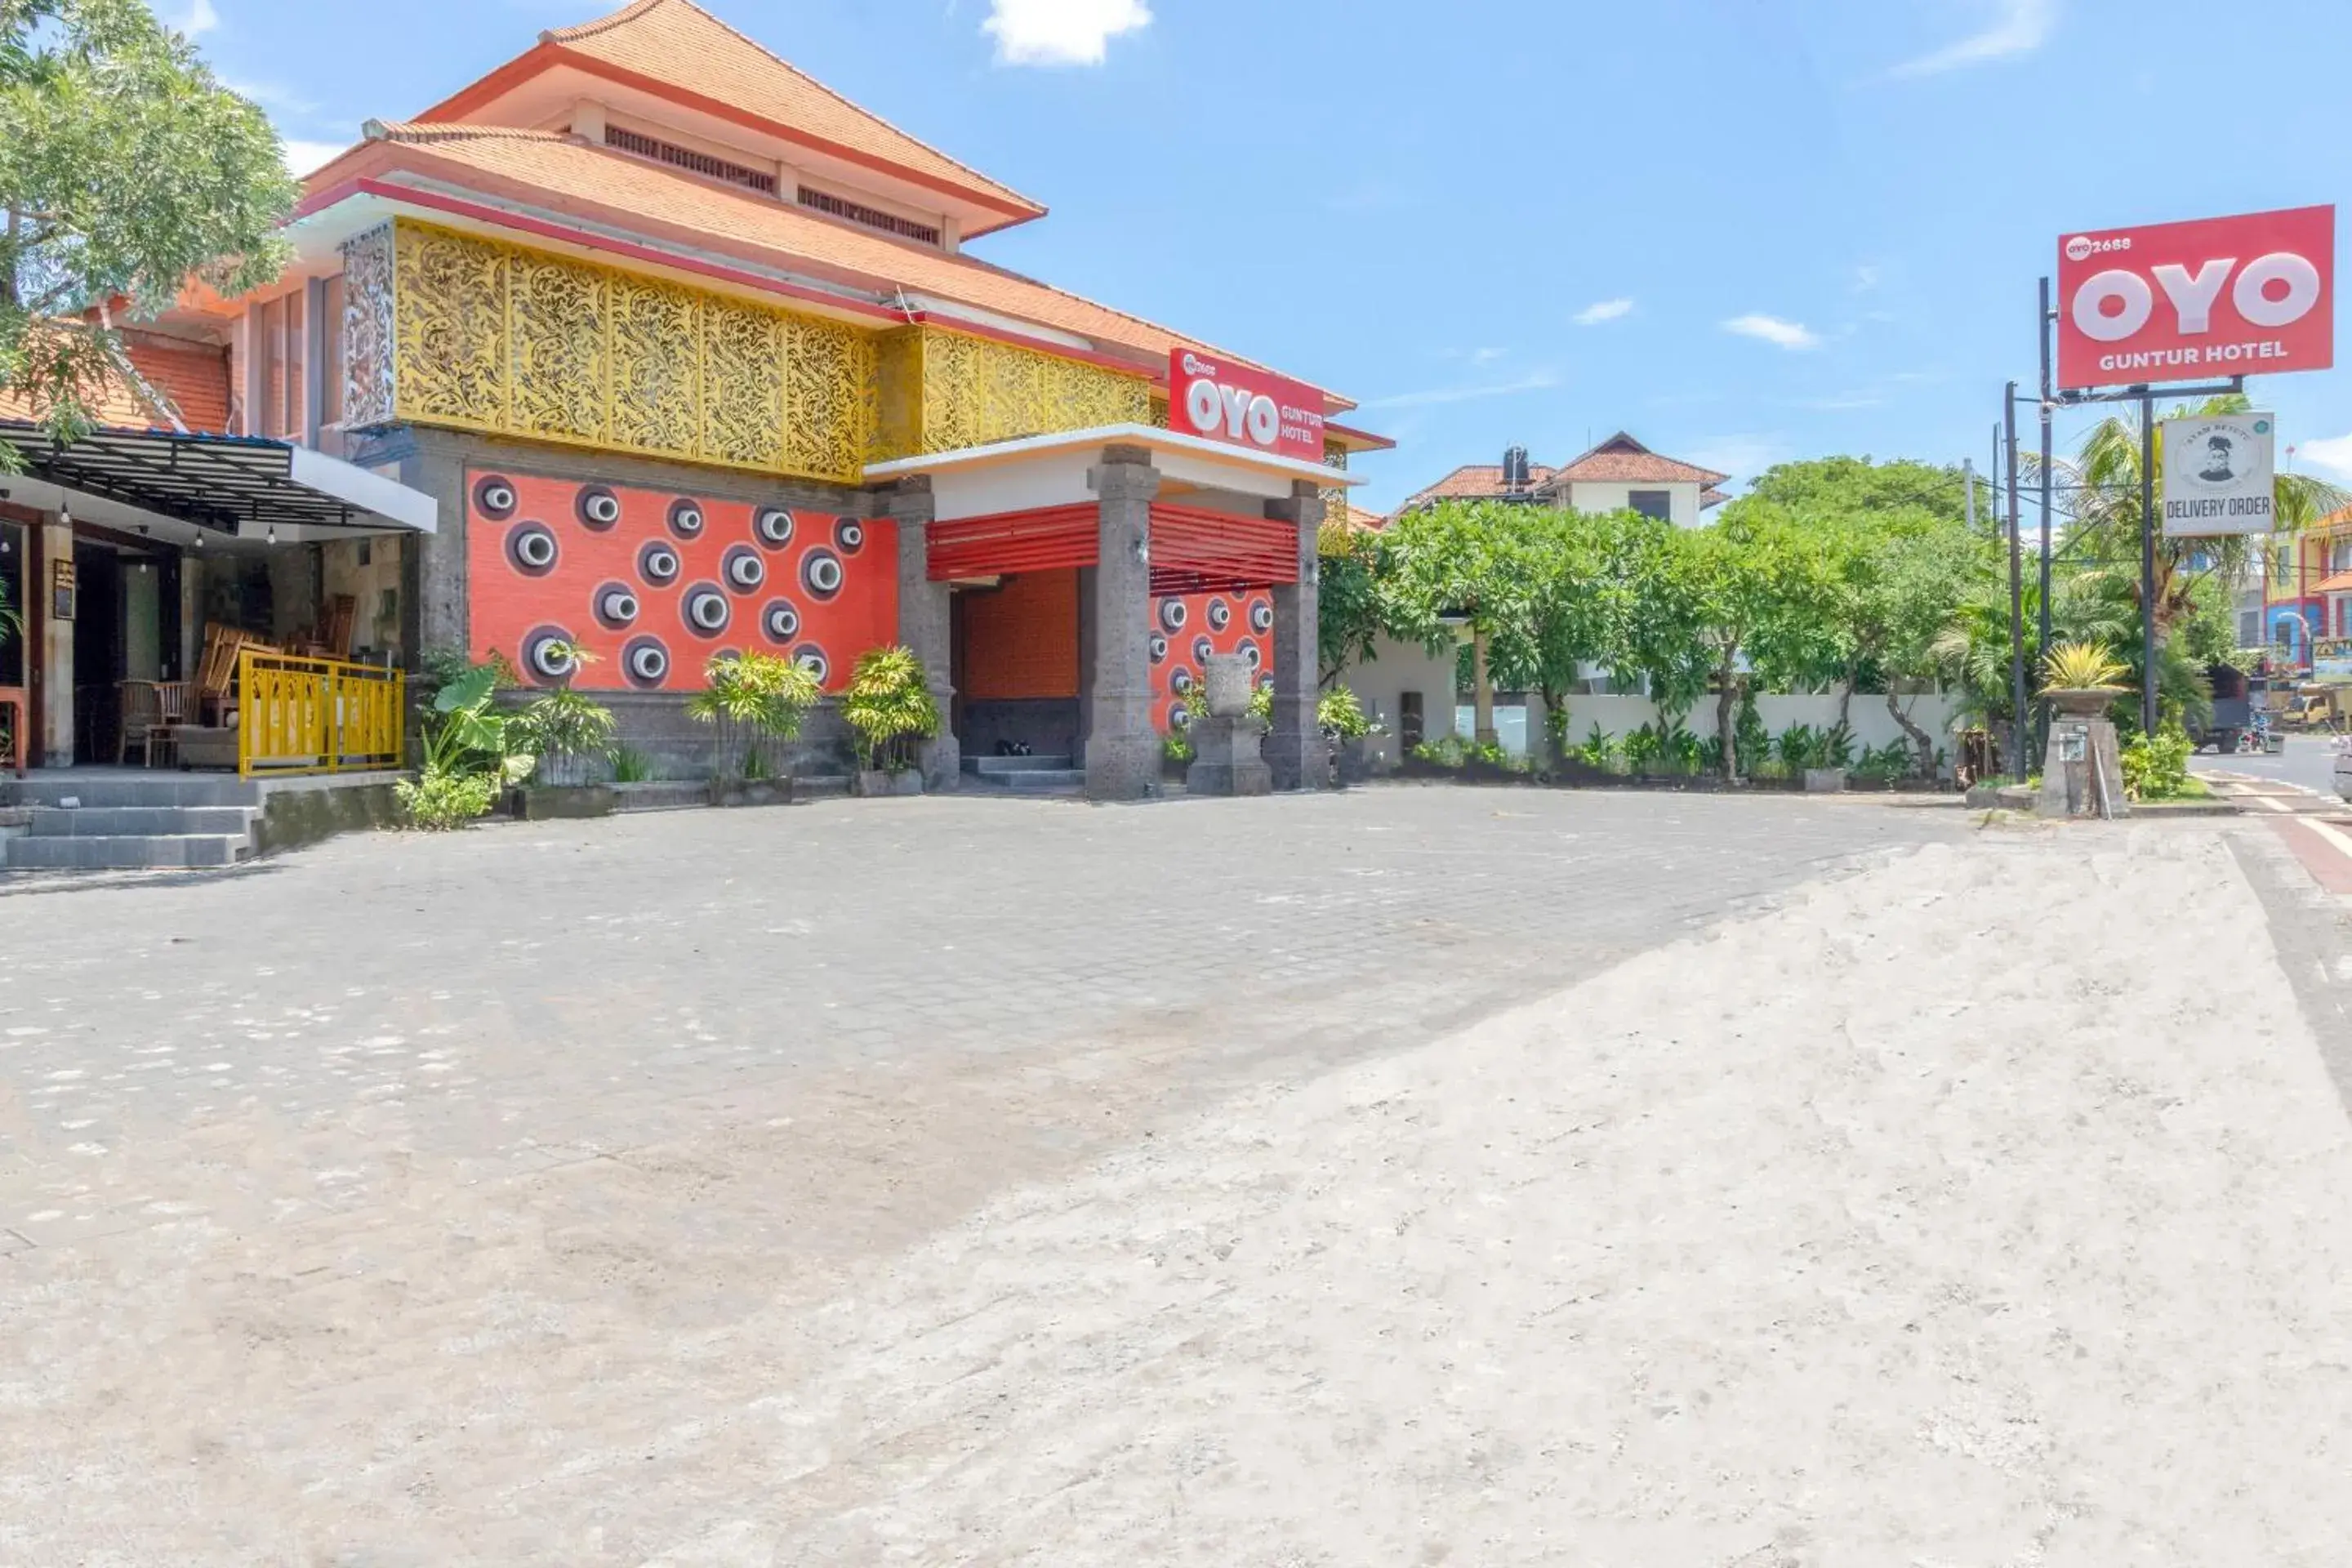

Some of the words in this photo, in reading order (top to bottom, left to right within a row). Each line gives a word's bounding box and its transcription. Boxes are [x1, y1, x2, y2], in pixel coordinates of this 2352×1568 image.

[2073, 252, 2320, 341] OYO
[2099, 348, 2200, 370] GUNTUR
[2206, 341, 2288, 362] HOTEL
[1187, 379, 1280, 445] OYO
[1281, 405, 1323, 427] GUNTUR
[1281, 424, 1315, 444] HOTEL
[2167, 499, 2225, 518] DELIVERY
[2229, 497, 2270, 515] ORDER
